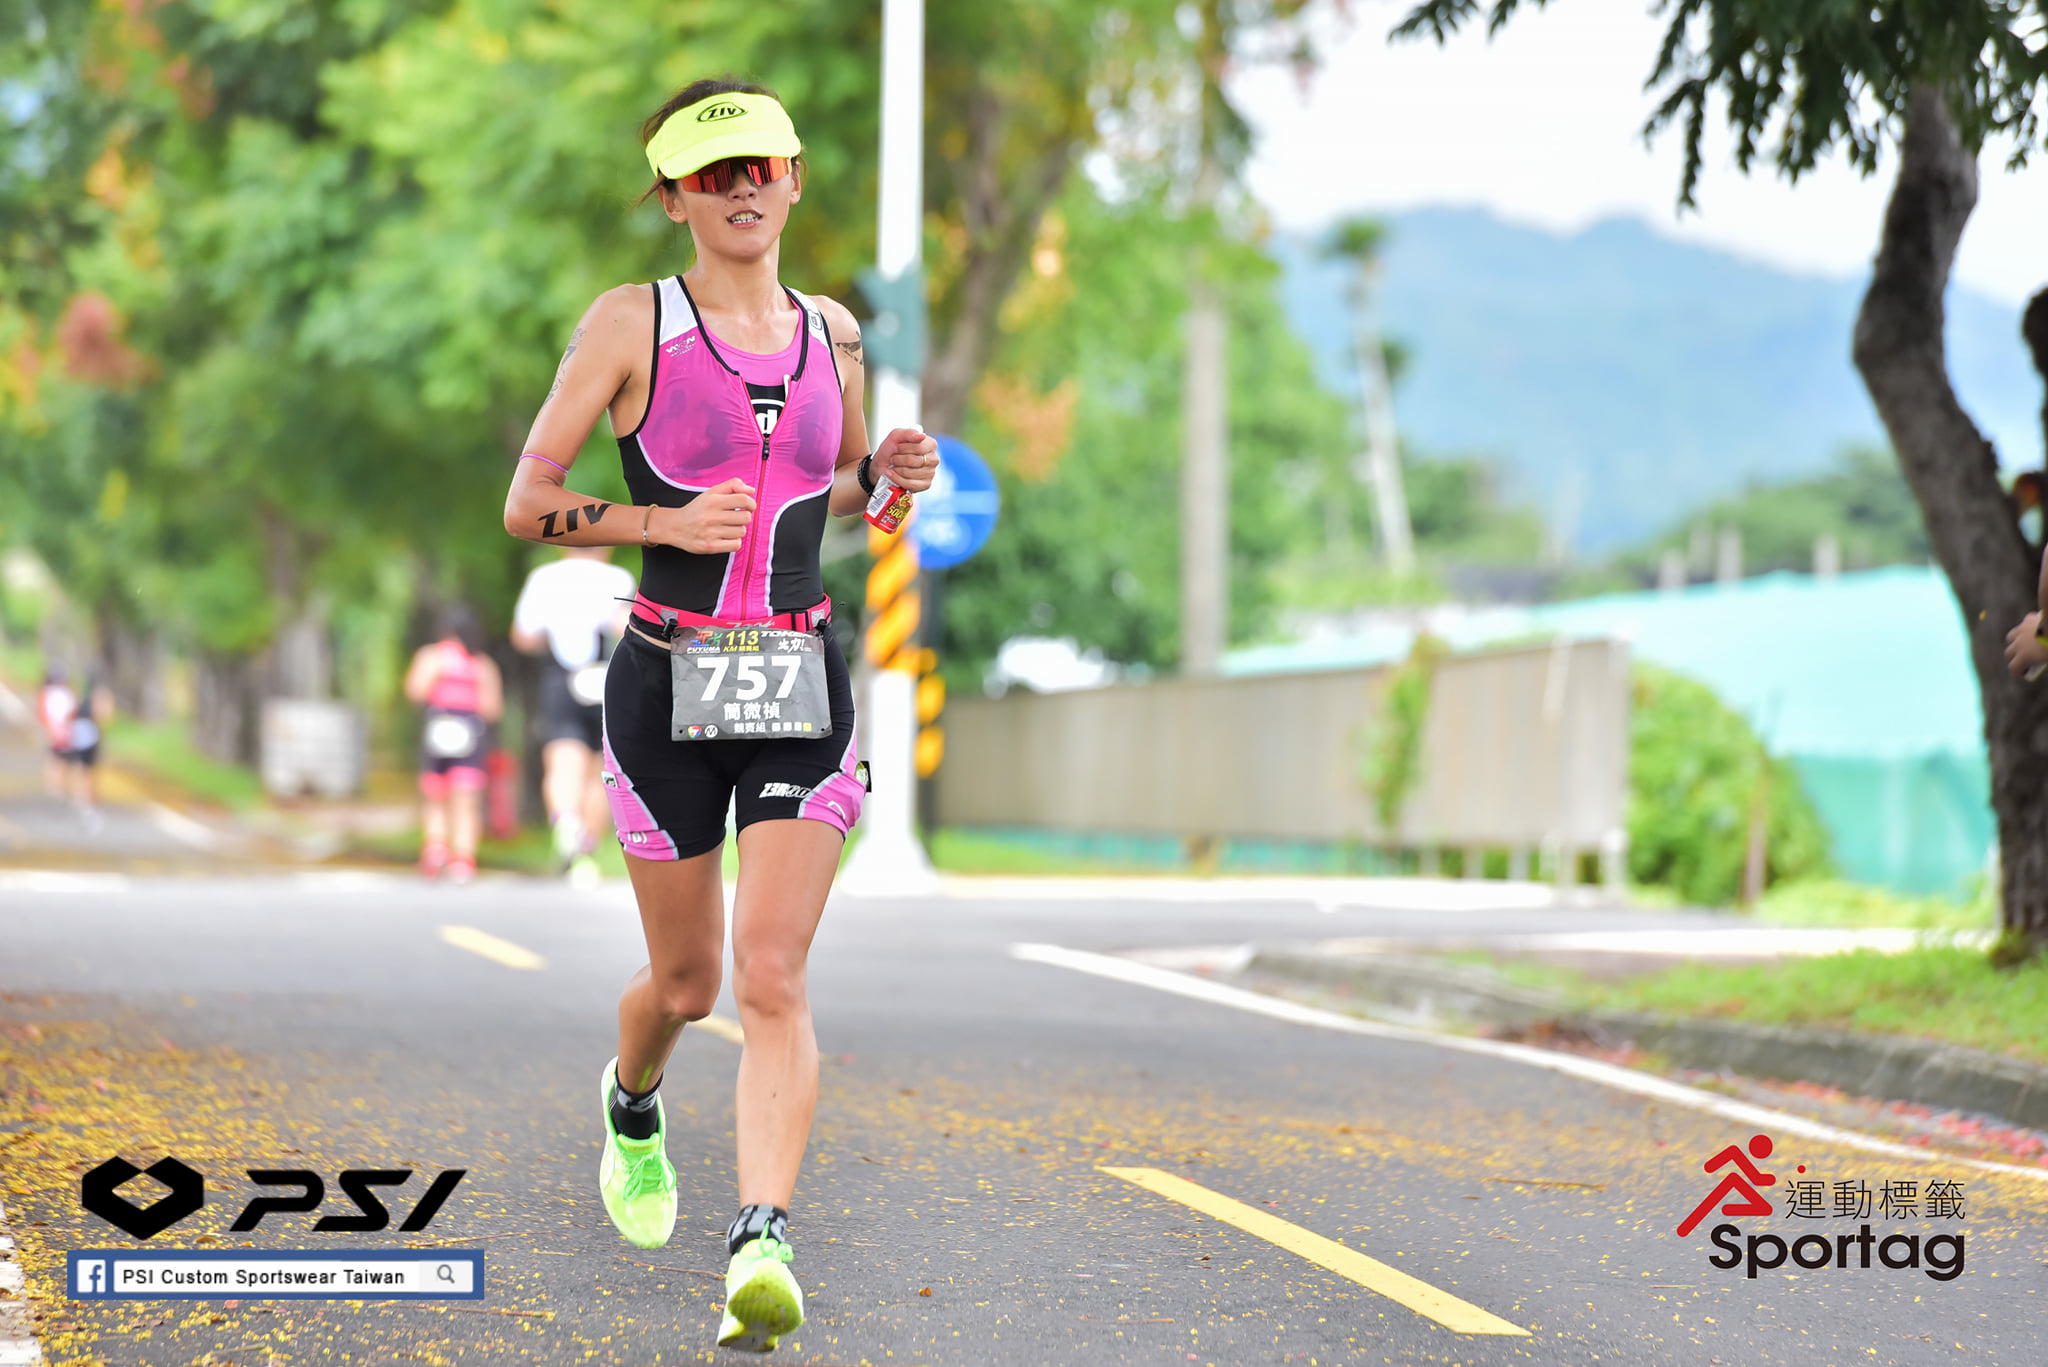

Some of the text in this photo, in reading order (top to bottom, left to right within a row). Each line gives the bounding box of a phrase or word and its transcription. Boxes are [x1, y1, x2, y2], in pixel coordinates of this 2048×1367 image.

[707, 106, 737, 120] ZIV
[537, 502, 613, 538] ZIV
[725, 630, 760, 646] 113
[723, 645, 738, 653] KM
[697, 655, 802, 702] 757
